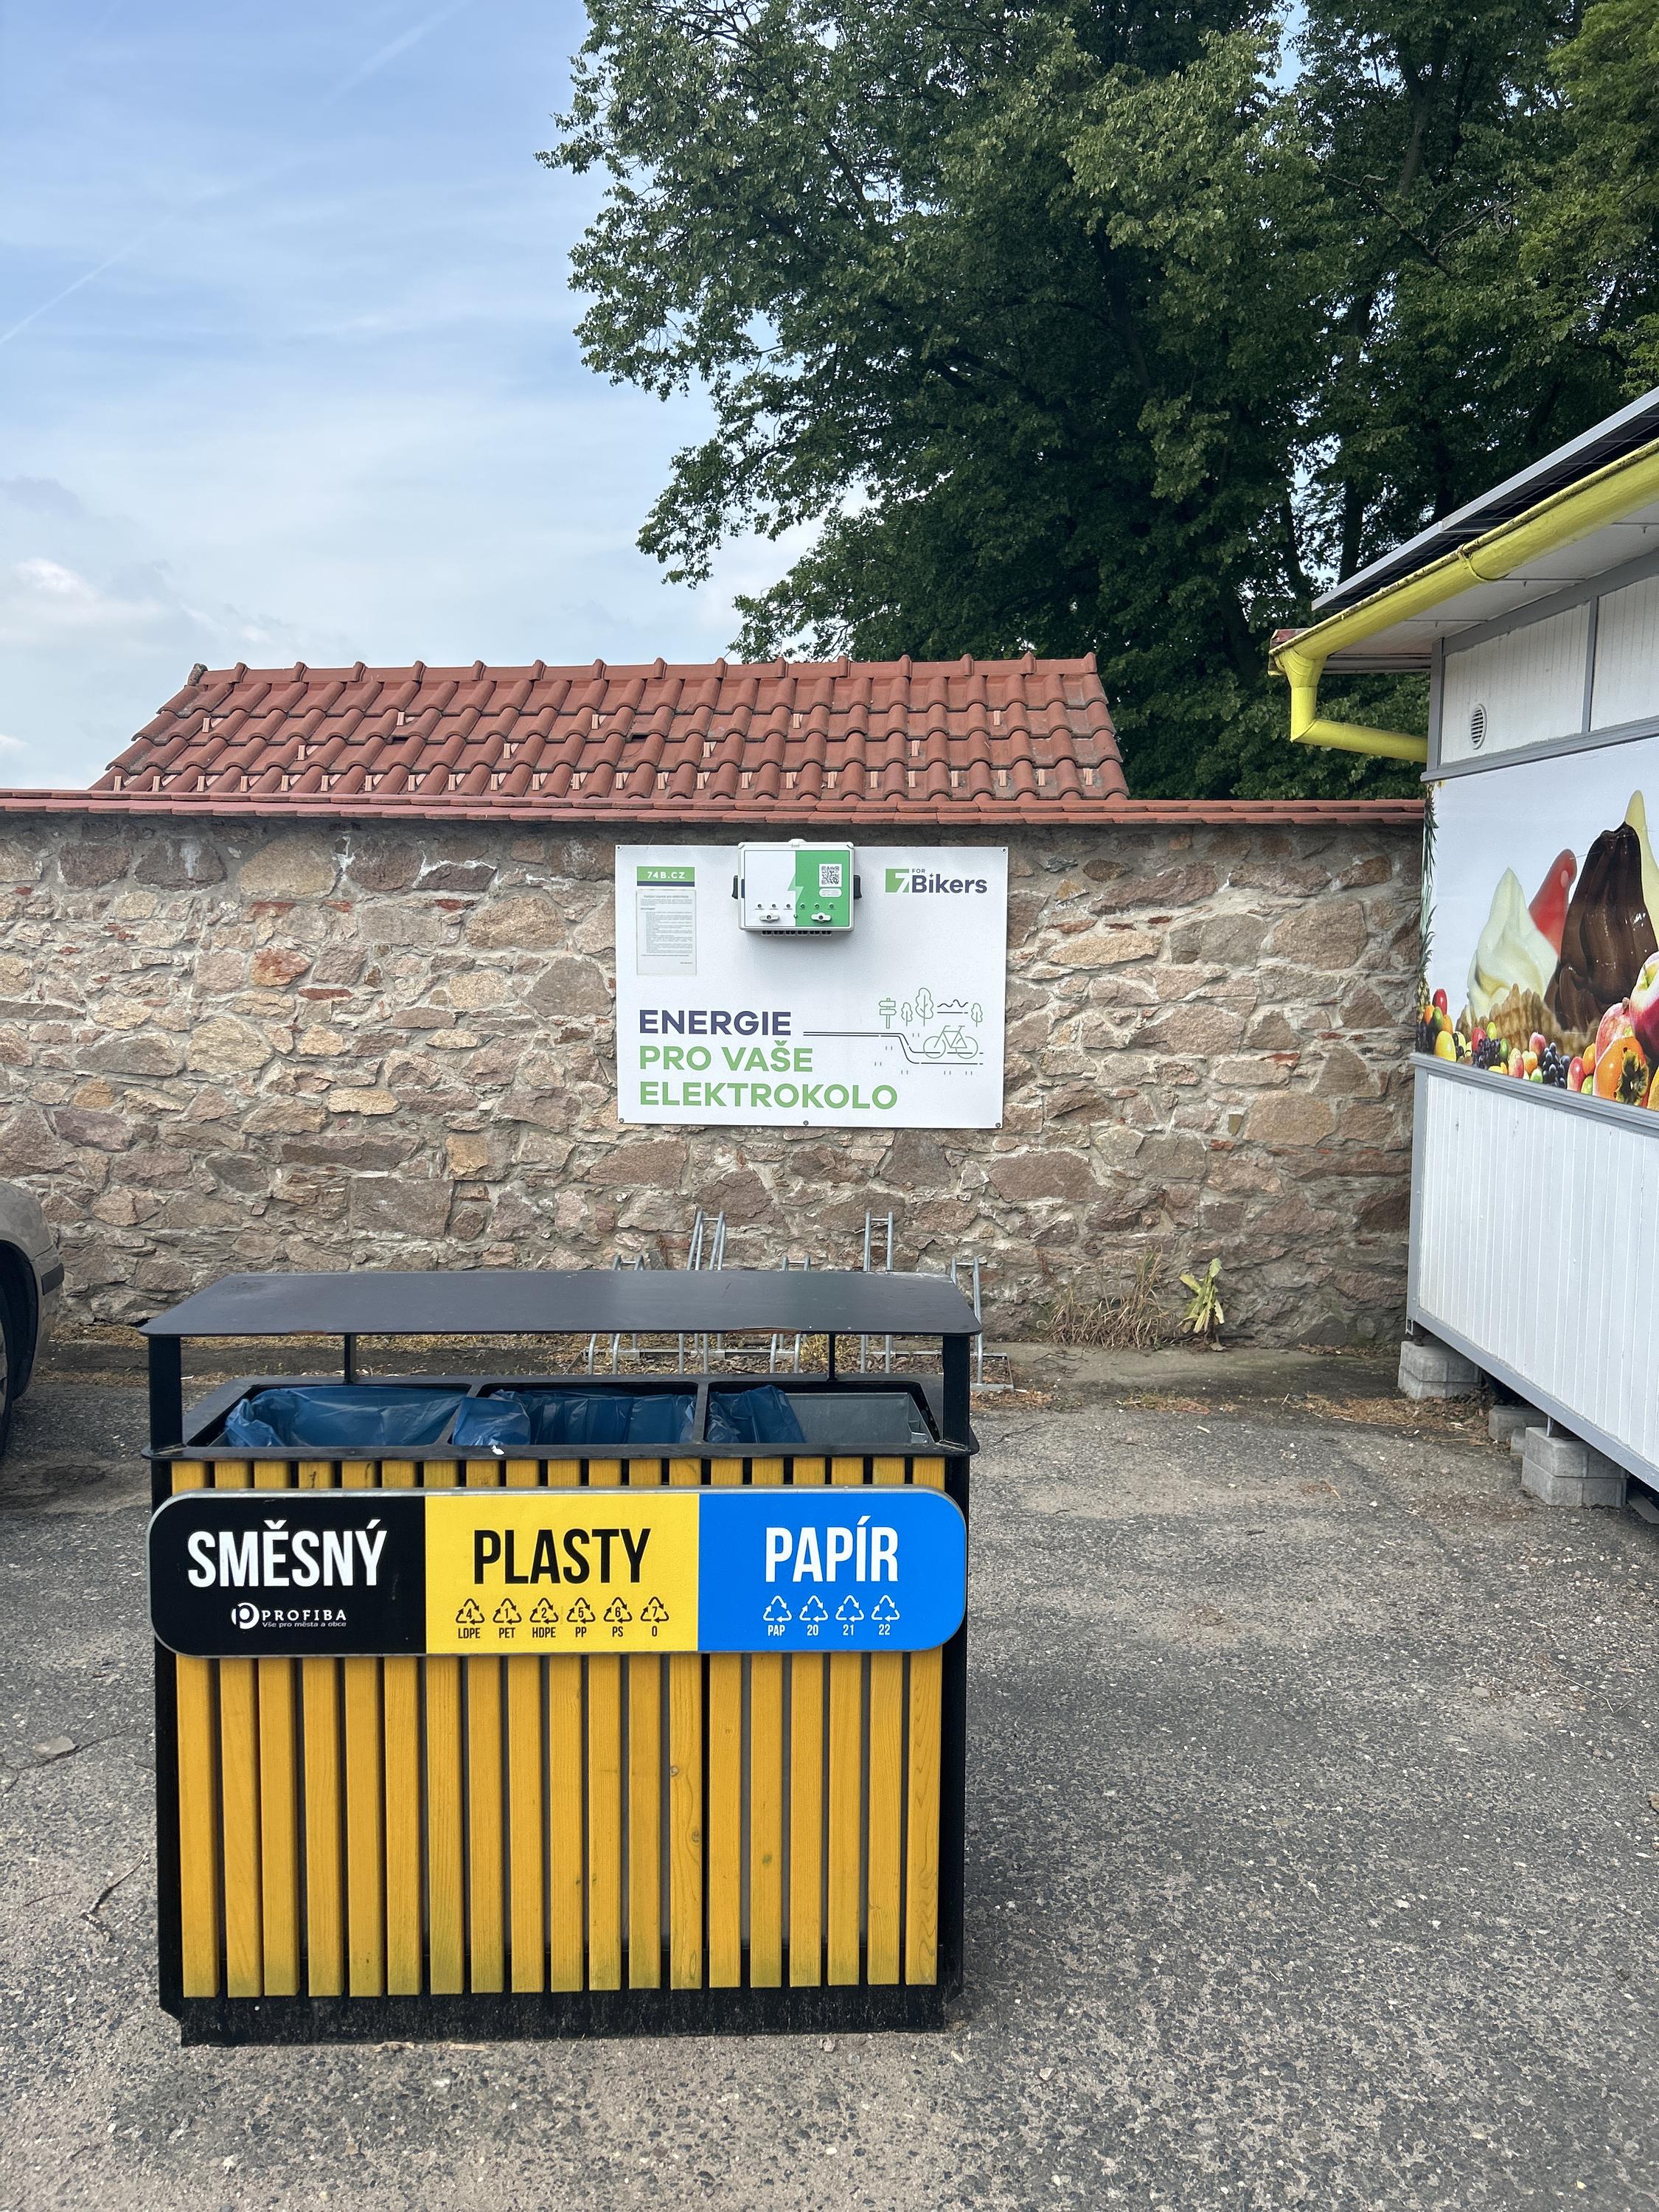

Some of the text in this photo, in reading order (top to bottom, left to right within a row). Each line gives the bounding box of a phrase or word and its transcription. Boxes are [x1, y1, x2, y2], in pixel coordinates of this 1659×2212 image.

[647, 871, 685, 880] 74B.CZ
[911, 873, 987, 894] Bikers
[640, 1010, 790, 1035] ENERGIE
[640, 1040, 813, 1072] PRO VAŠE
[641, 1082, 897, 1109] ELEKTROKOLO
[188, 1520, 387, 1587] SMĚSNÝ
[475, 1528, 651, 1584] PLASTY
[766, 1516, 898, 1582] PAPÍR
[261, 1609, 347, 1621] PROFIBA
[465, 1606, 659, 1620] 4 1 2 5 6 7
[458, 1627, 481, 1639] LDPE
[498, 1627, 516, 1639] PET
[532, 1627, 557, 1638] HDPE
[575, 1626, 587, 1638] PP
[612, 1626, 624, 1638] PS
[768, 1623, 891, 1637] PAP 20 21 22
